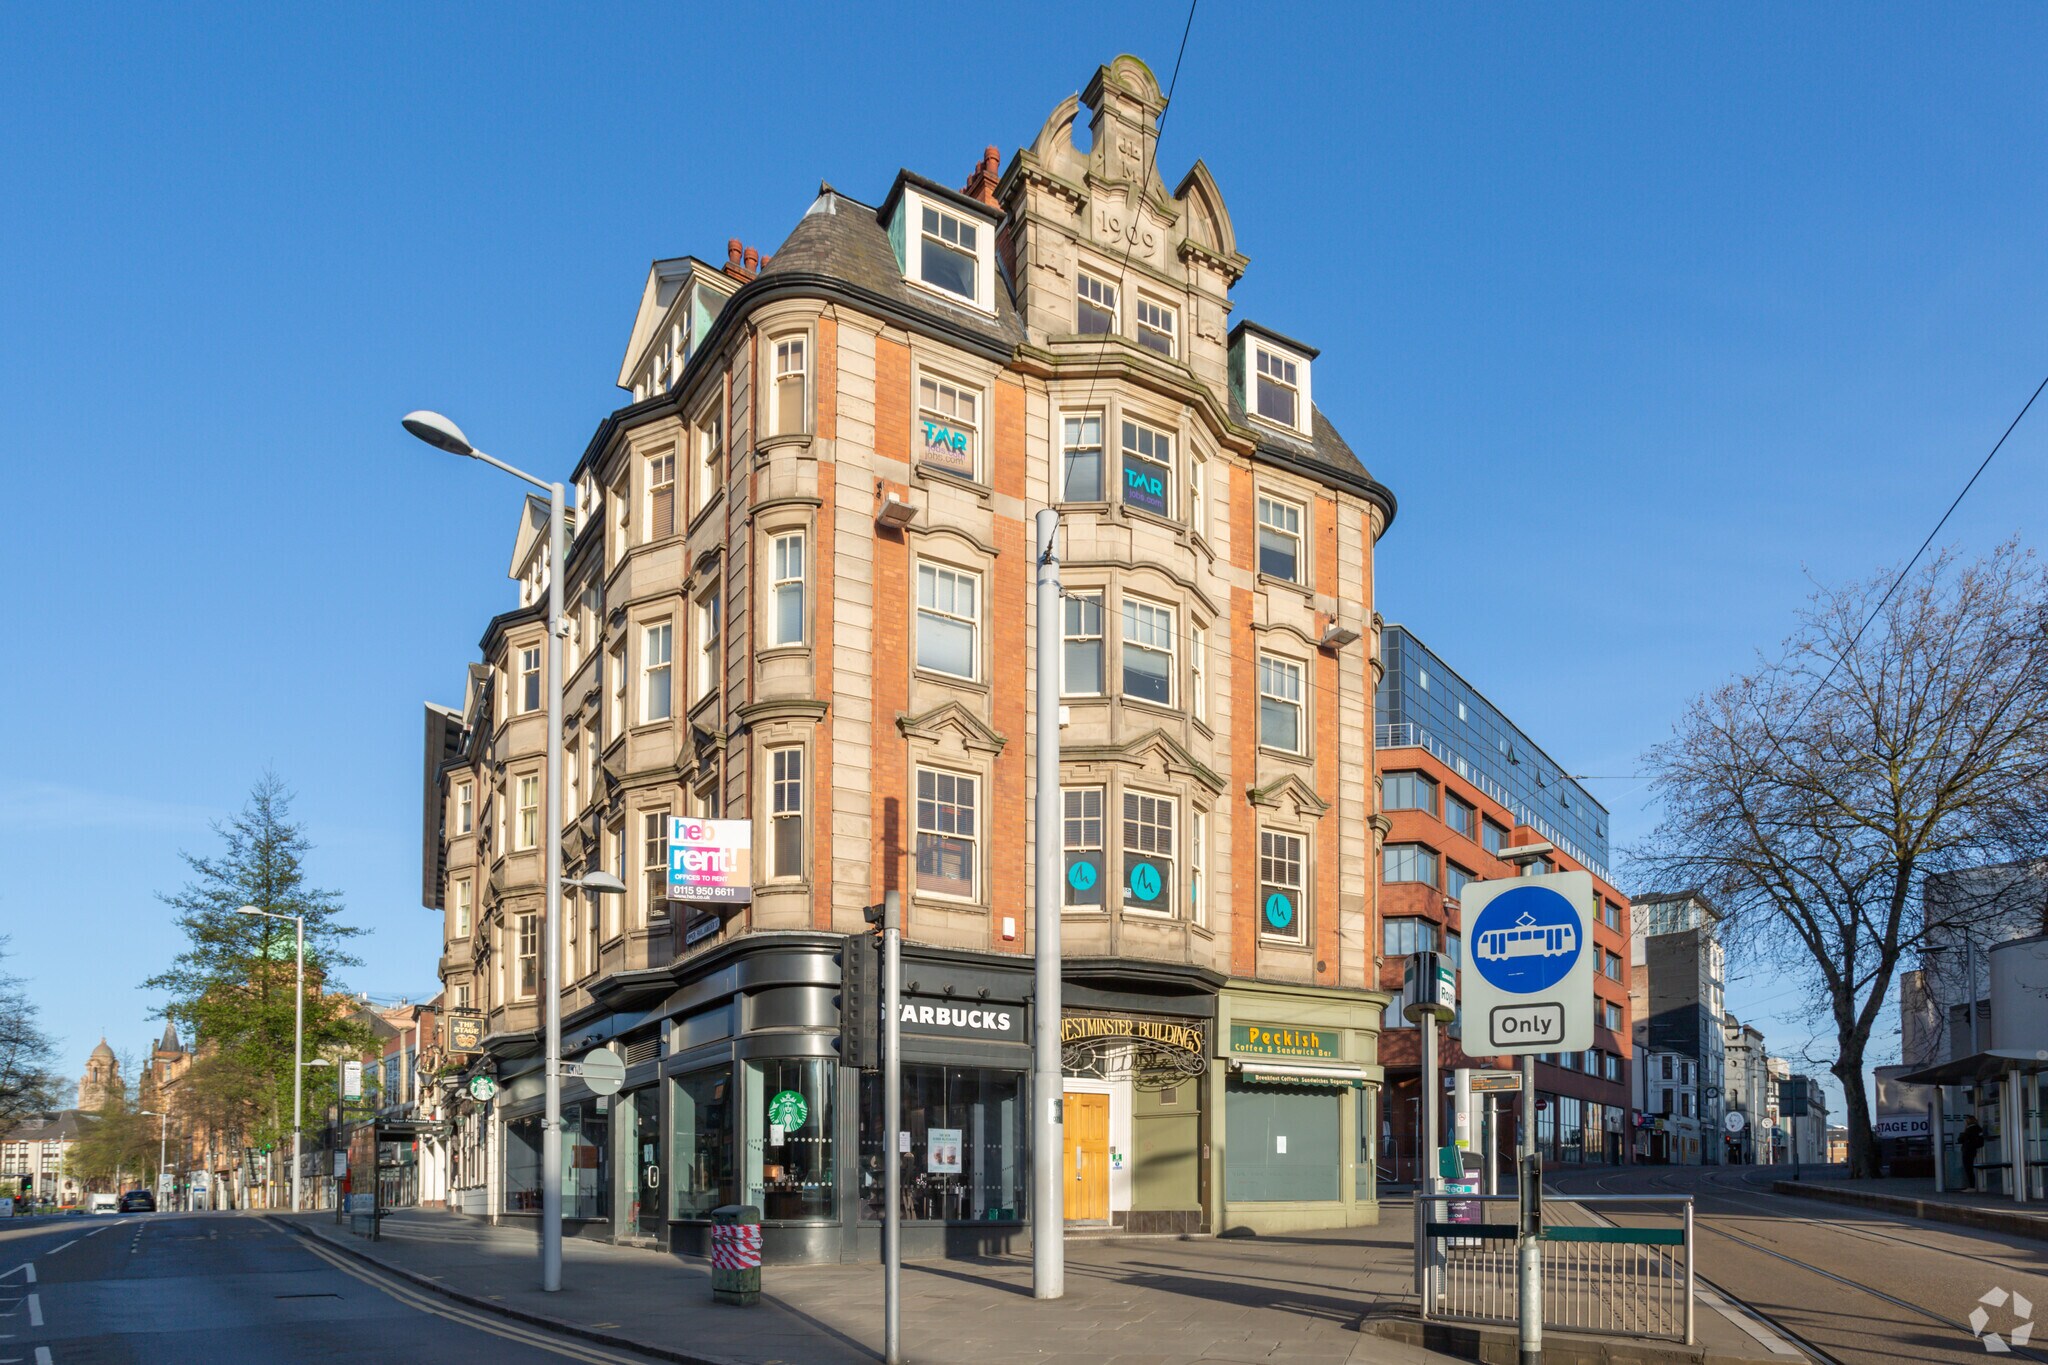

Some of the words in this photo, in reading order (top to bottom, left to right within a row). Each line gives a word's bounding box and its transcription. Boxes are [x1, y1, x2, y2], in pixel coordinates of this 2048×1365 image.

[1097, 210, 1156, 258] 1909
[923, 421, 967, 451] TMR
[1124, 468, 1163, 497] TMR
[674, 819, 715, 841] heb
[673, 846, 737, 872] rent!
[674, 873, 701, 881] OFFICES
[702, 874, 711, 882] TO
[673, 885, 695, 895] 0115
[696, 886, 713, 896] 950
[714, 887, 735, 897] 6611
[453, 1027, 479, 1035] STAGE
[458, 1020, 476, 1028] THE
[1502, 1015, 1552, 1035] Only
[1138, 1020, 1202, 1054] BUILDINGS
[1248, 1027, 1320, 1048] Peckish
[1234, 1043, 1263, 1053] Coffee
[1267, 1045, 1273, 1053] &
[1276, 1045, 1315, 1056] Sandwich
[1318, 1049, 1332, 1057] Bar
[1876, 1121, 1908, 1133] STAGE
